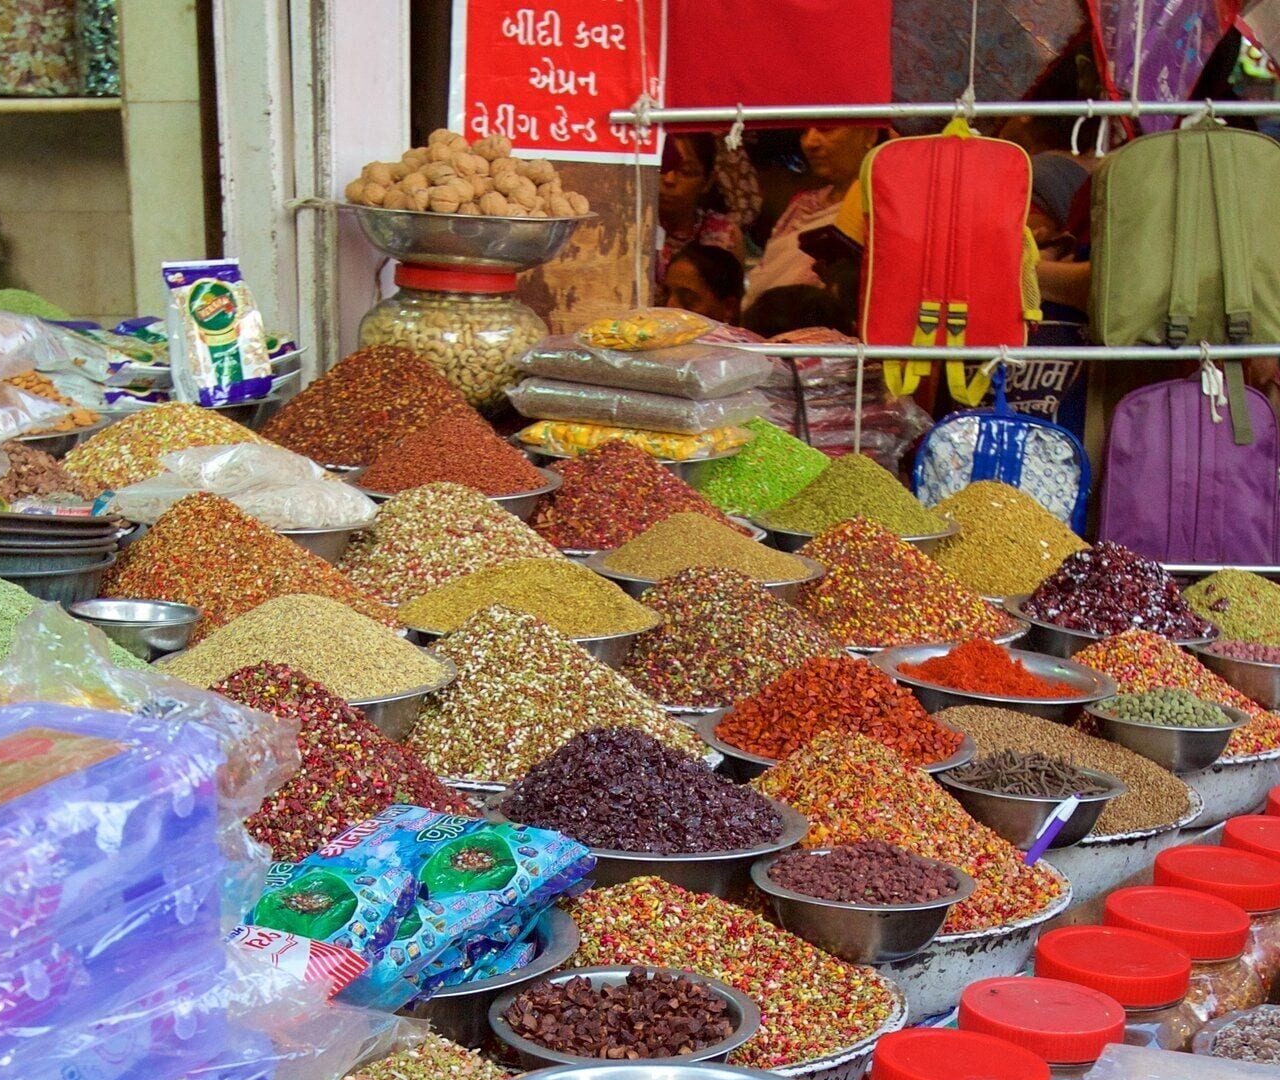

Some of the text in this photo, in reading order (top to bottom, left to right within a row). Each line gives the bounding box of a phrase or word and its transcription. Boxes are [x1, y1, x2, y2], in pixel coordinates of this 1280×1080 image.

[574, 21, 626, 50] કવર
[528, 56, 598, 96] એપ્રન
[549, 105, 598, 142] હેન્ડ
